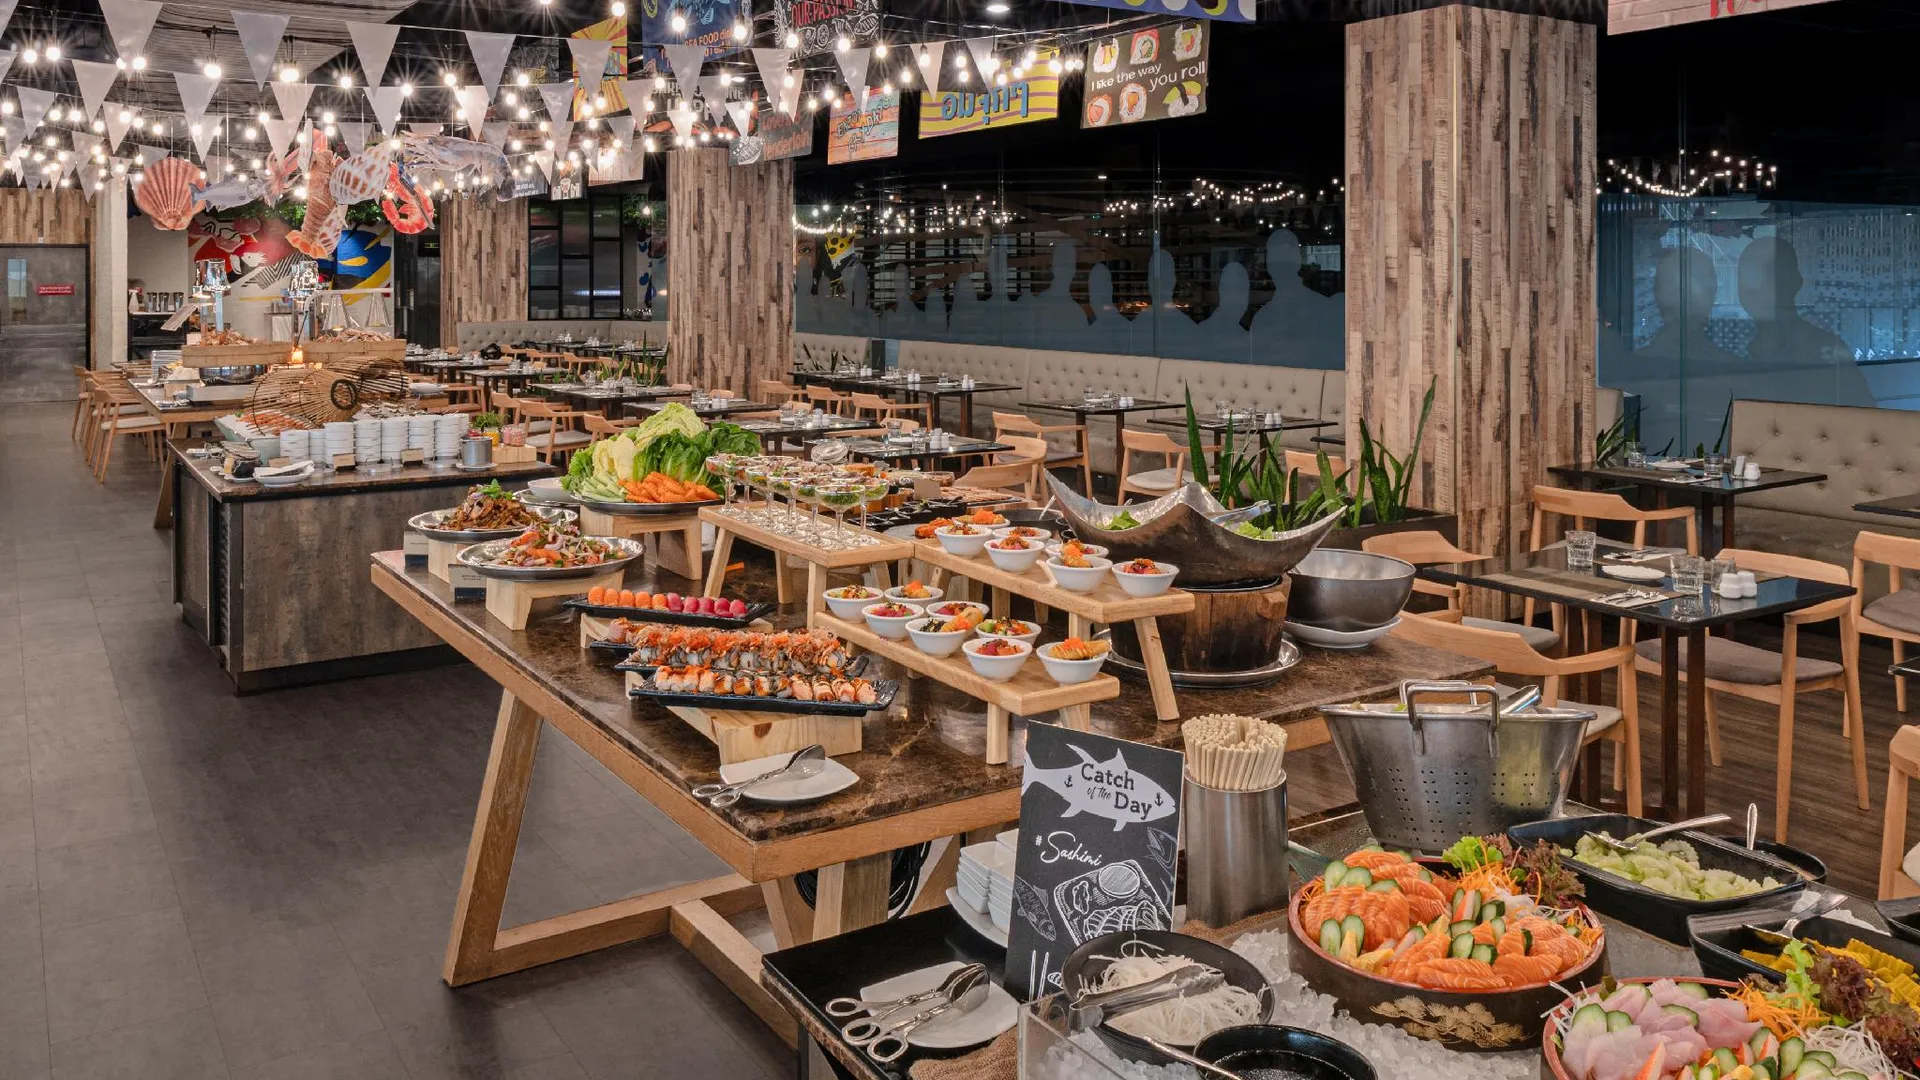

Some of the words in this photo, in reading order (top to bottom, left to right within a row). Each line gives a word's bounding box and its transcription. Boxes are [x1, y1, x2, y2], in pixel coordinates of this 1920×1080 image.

[699, 31, 718, 46] FOOD
[1091, 81, 1095, 91] I
[1096, 78, 1114, 89] like
[1117, 71, 1136, 82] the
[1138, 63, 1162, 77] way
[1148, 72, 1177, 92] you
[1181, 61, 1206, 79] roll
[1081, 763, 1134, 790] Catch
[1087, 786, 1097, 800] of
[1114, 791, 1152, 820] Day
